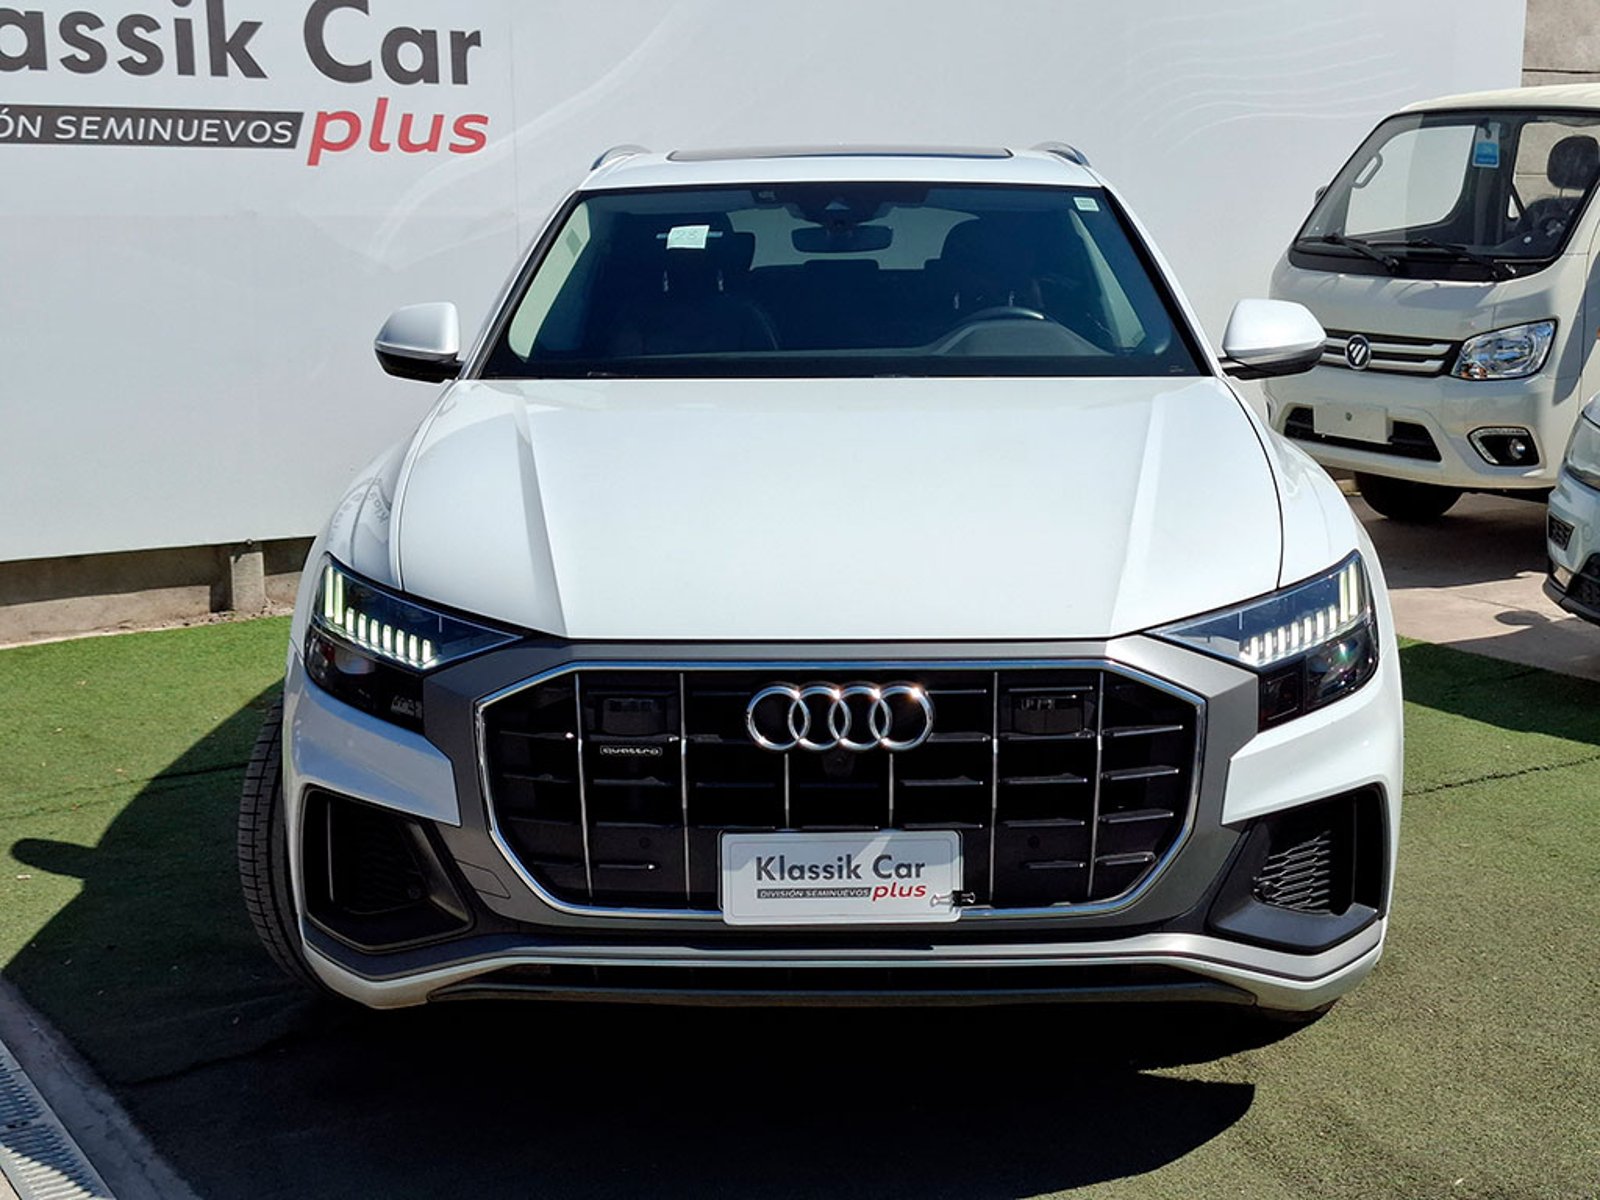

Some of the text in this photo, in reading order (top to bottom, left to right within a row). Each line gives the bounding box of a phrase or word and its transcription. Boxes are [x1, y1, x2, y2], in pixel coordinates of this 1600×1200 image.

[303, 0, 482, 85] Car
[54, 114, 293, 144] SEMINUEVOS
[307, 97, 489, 166] plus
[755, 854, 926, 881] Klassik Car
[805, 887, 870, 898] SEMINUEVOS
[872, 881, 927, 902] plus
